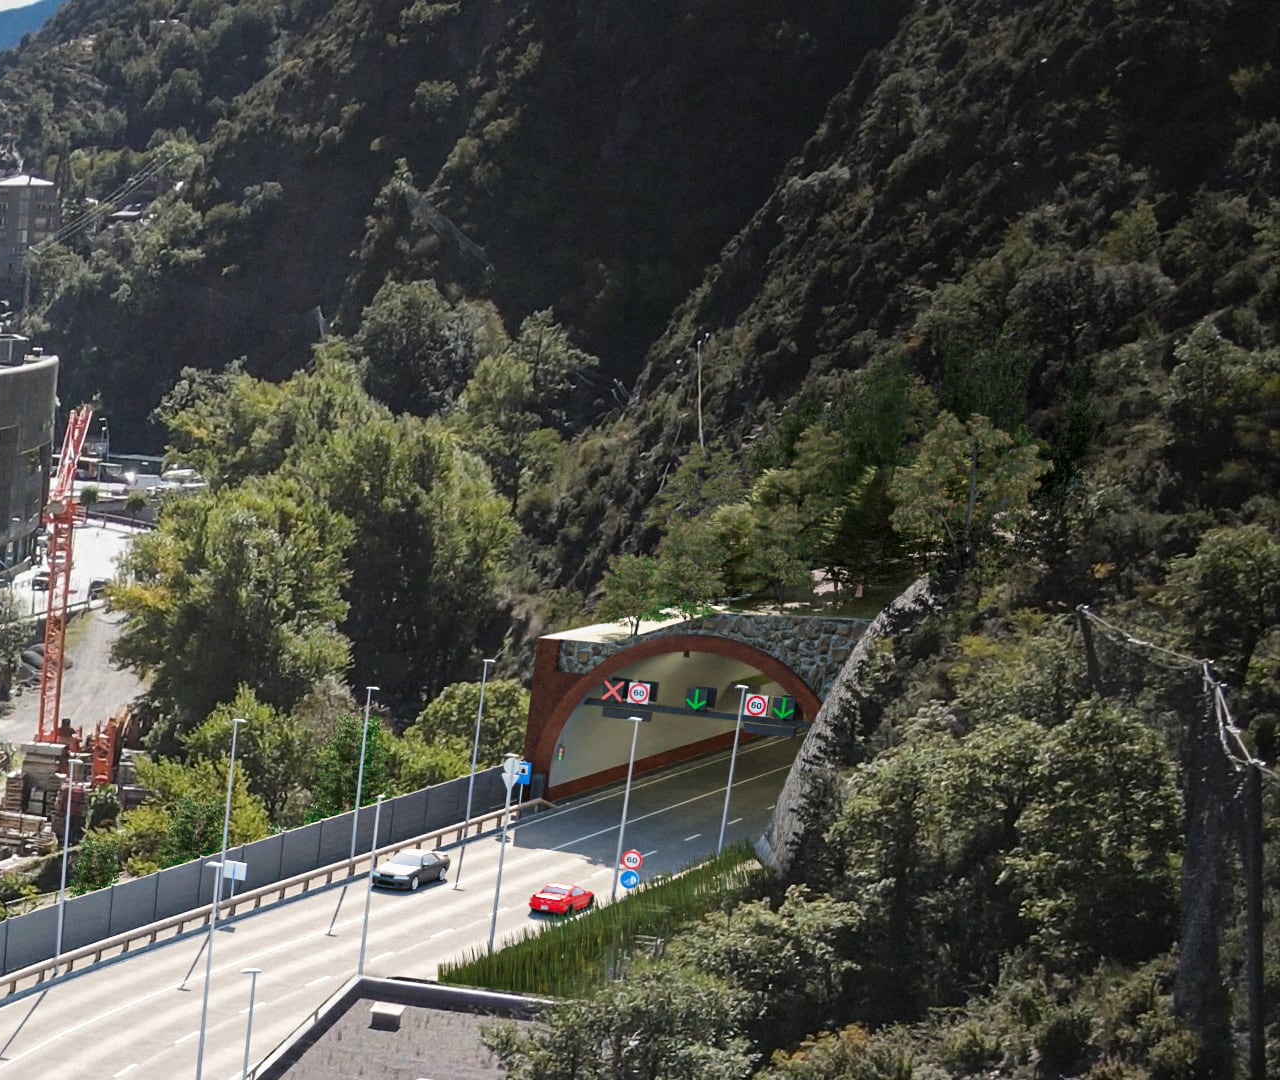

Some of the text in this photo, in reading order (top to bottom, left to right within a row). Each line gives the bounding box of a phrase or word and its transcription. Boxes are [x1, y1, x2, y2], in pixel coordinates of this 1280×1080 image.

[633, 689, 645, 697] 60
[750, 701, 762, 710] 60
[626, 855, 638, 864] 60
